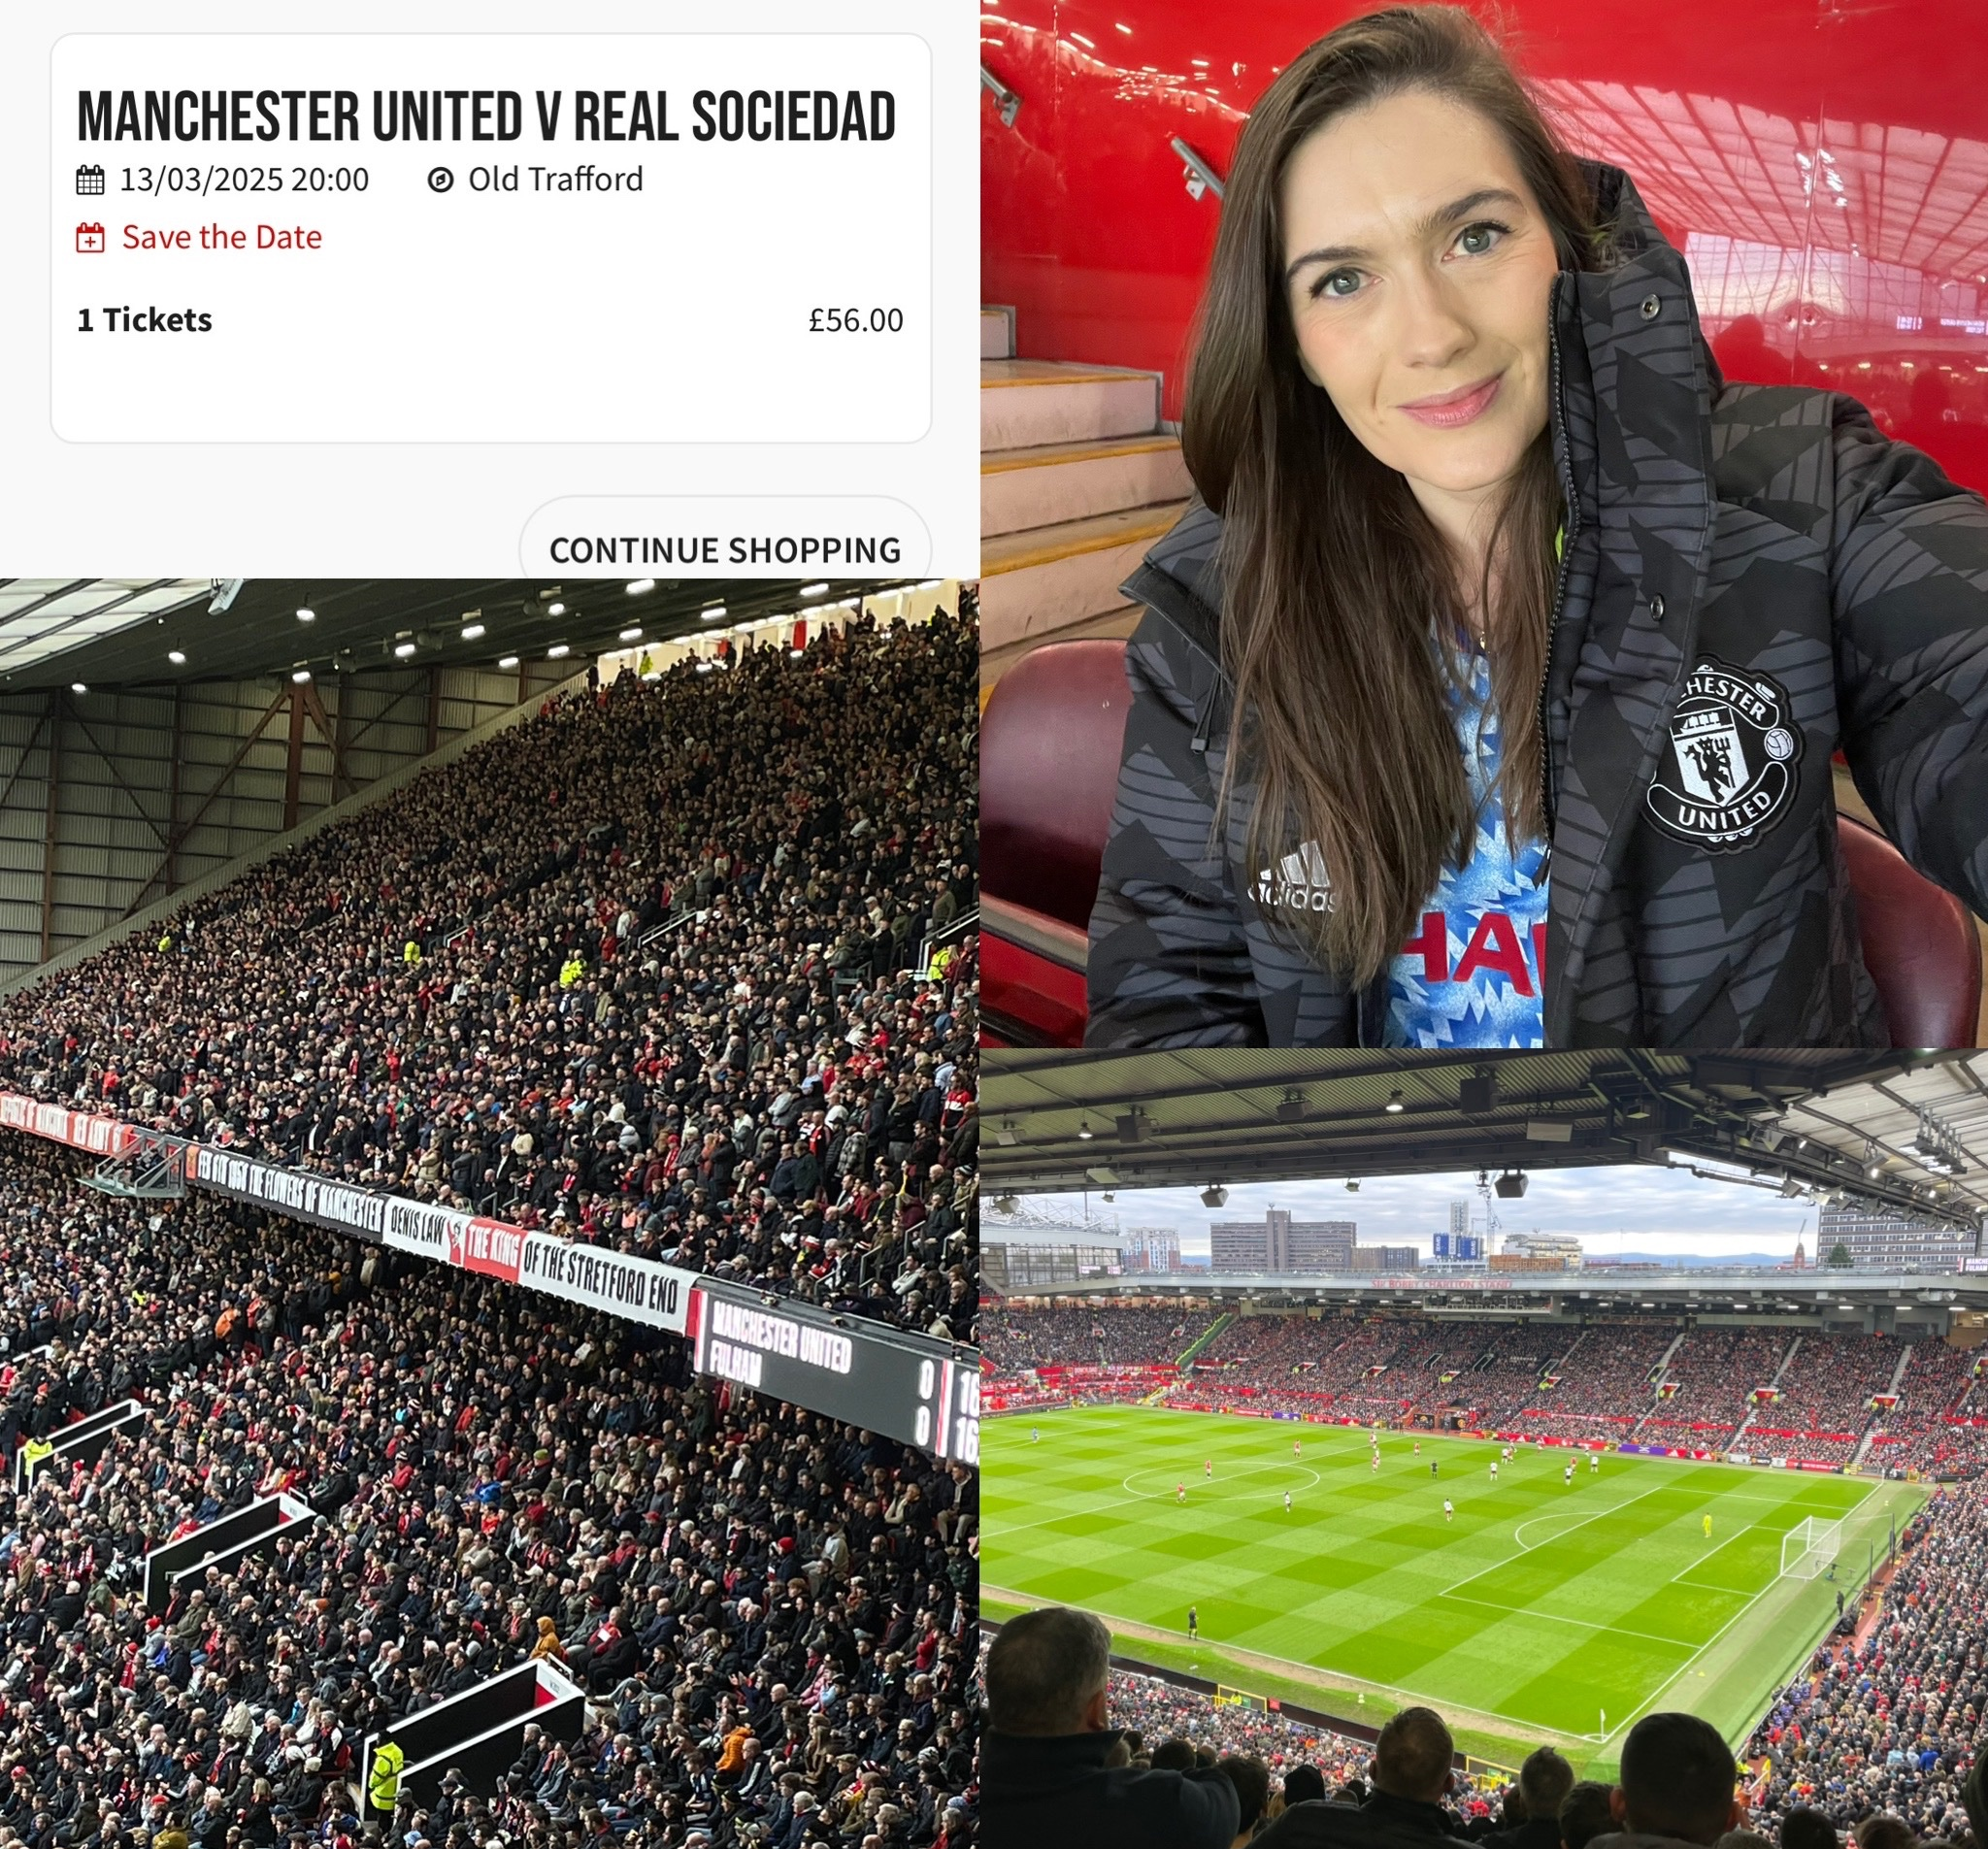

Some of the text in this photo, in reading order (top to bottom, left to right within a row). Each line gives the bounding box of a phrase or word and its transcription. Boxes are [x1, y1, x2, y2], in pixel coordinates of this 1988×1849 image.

[78, 89, 896, 142] MANCHESTER UNITED V REAL SOCIEDAD
[120, 164, 369, 197] 13/03/2025 20:00
[469, 164, 643, 192] Old Trafford
[122, 222, 322, 250] Save the Date
[78, 305, 213, 333] 1 Tickets
[809, 308, 904, 333] £56.00
[549, 537, 901, 564] CONTINUE SHOPPING
[1678, 791, 1772, 830] UNITED
[264, 1169, 306, 1209] FLOWERS
[305, 1180, 320, 1213] OF
[318, 1184, 384, 1233] MANCHESTER
[390, 1205, 447, 1245] DENIS LAW
[468, 1224, 521, 1269] THE KING
[524, 1240, 679, 1315] OF THE STRETFORD END
[712, 1301, 799, 1359] MANCHESTER
[799, 1326, 852, 1375] UNITED
[918, 1359, 935, 1401] 0
[709, 1339, 763, 1388] FULHAM
[914, 1405, 931, 1447] 0
